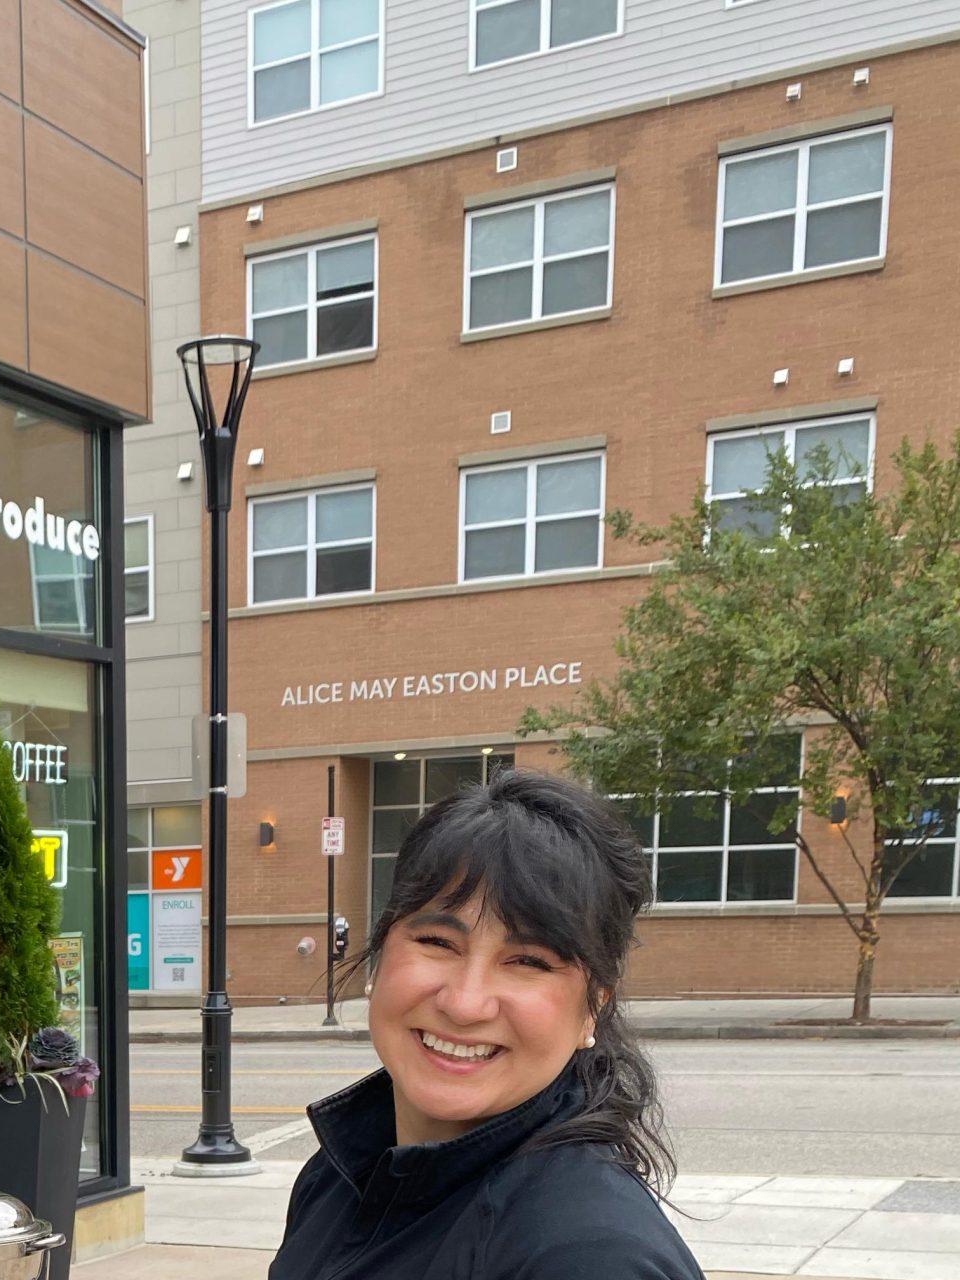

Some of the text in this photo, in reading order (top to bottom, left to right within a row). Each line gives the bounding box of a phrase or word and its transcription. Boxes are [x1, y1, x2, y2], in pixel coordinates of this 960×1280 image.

[281, 662, 583, 706] ALICE MAY EASTON PLACE
[162, 900, 195, 910] ENROLL
